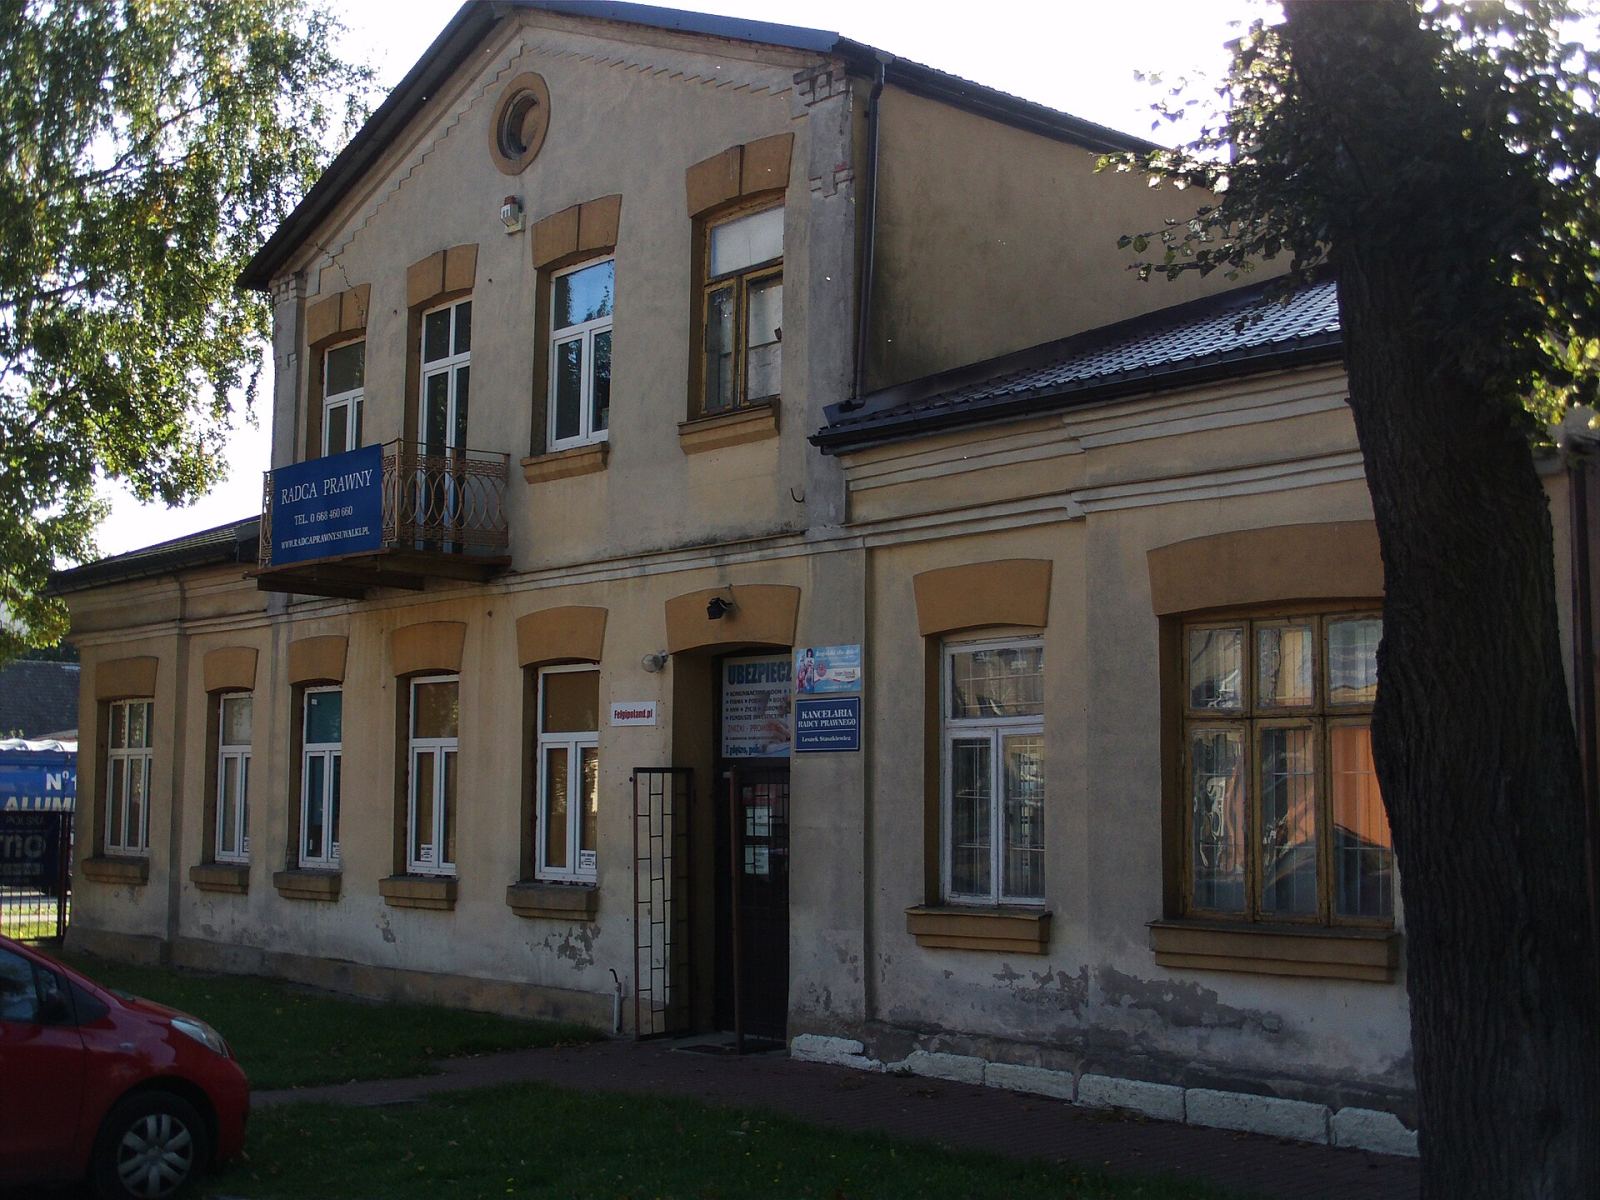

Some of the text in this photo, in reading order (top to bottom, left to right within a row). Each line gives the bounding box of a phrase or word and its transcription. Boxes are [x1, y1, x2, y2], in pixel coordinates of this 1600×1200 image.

[281, 469, 373, 505] RADCA PRAWNY
[294, 514, 308, 526] TEL.
[310, 513, 315, 523] 0
[614, 709, 653, 720] Felgipoland.pl
[801, 709, 853, 719] KANCELARIA
[798, 718, 856, 728] RADCY PRAWNEGO
